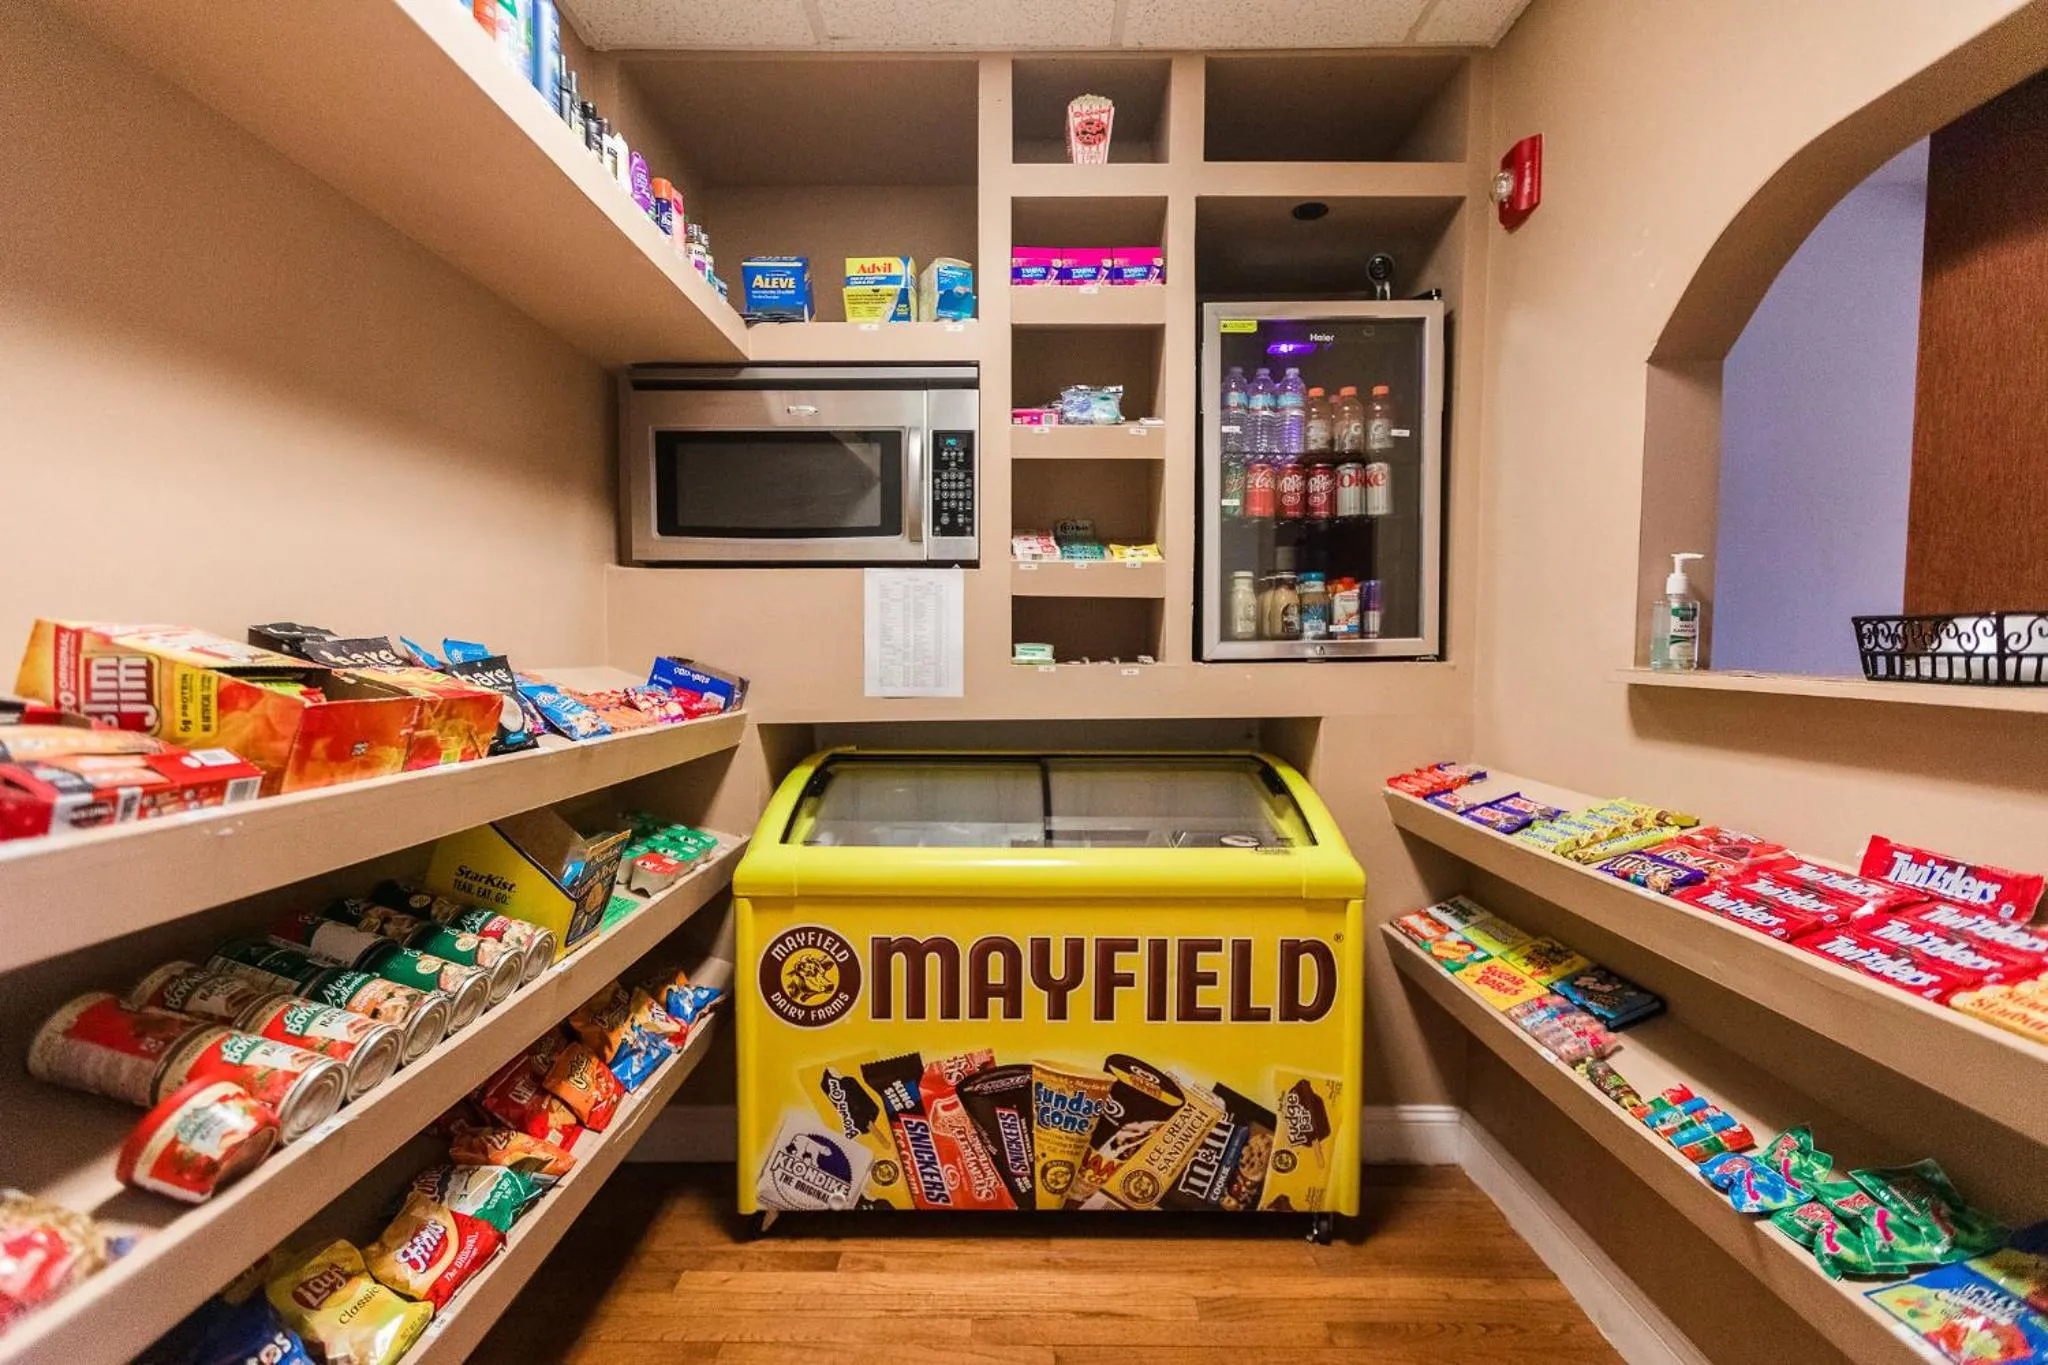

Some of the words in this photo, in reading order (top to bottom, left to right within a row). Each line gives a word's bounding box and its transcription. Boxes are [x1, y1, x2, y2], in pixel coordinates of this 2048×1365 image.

[752, 274, 796, 289] ALEVE
[857, 263, 892, 274] Advil
[1310, 333, 1335, 343] Haier
[320, 648, 402, 669] bare
[181, 673, 189, 718] PROTEIN
[455, 864, 516, 892] StarKist
[1892, 850, 2003, 904] Twizzlers
[1697, 891, 1786, 926] Twizzlers
[771, 931, 849, 963] MAYFIELD
[1818, 936, 1941, 986] Twizzlers
[1872, 919, 2002, 969] Twizzlers
[870, 935, 1338, 1023] MAYFIELD
[770, 991, 805, 1020] DAIRY
[811, 991, 850, 1022] FARMS
[883, 1087, 904, 1113] SIZE
[892, 1080, 914, 1110] KING
[1038, 1106, 1090, 1133] Cone
[1146, 1145, 1163, 1168] ICE
[1161, 1101, 1198, 1146] CREAM
[1287, 1092, 1302, 1147] Fudge
[999, 1111, 1029, 1174] SNICKERS
[1157, 1110, 1209, 1175] SANDWICH
[770, 1150, 851, 1196] KLONDIKE
[903, 1119, 947, 1205] SNICKERS
[778, 1172, 794, 1188] THE
[794, 1178, 830, 1203] ORIGINAL
[1211, 1166, 1233, 1200] COOKIE
[444, 1265, 459, 1284] The
[338, 1285, 381, 1326] Classic
